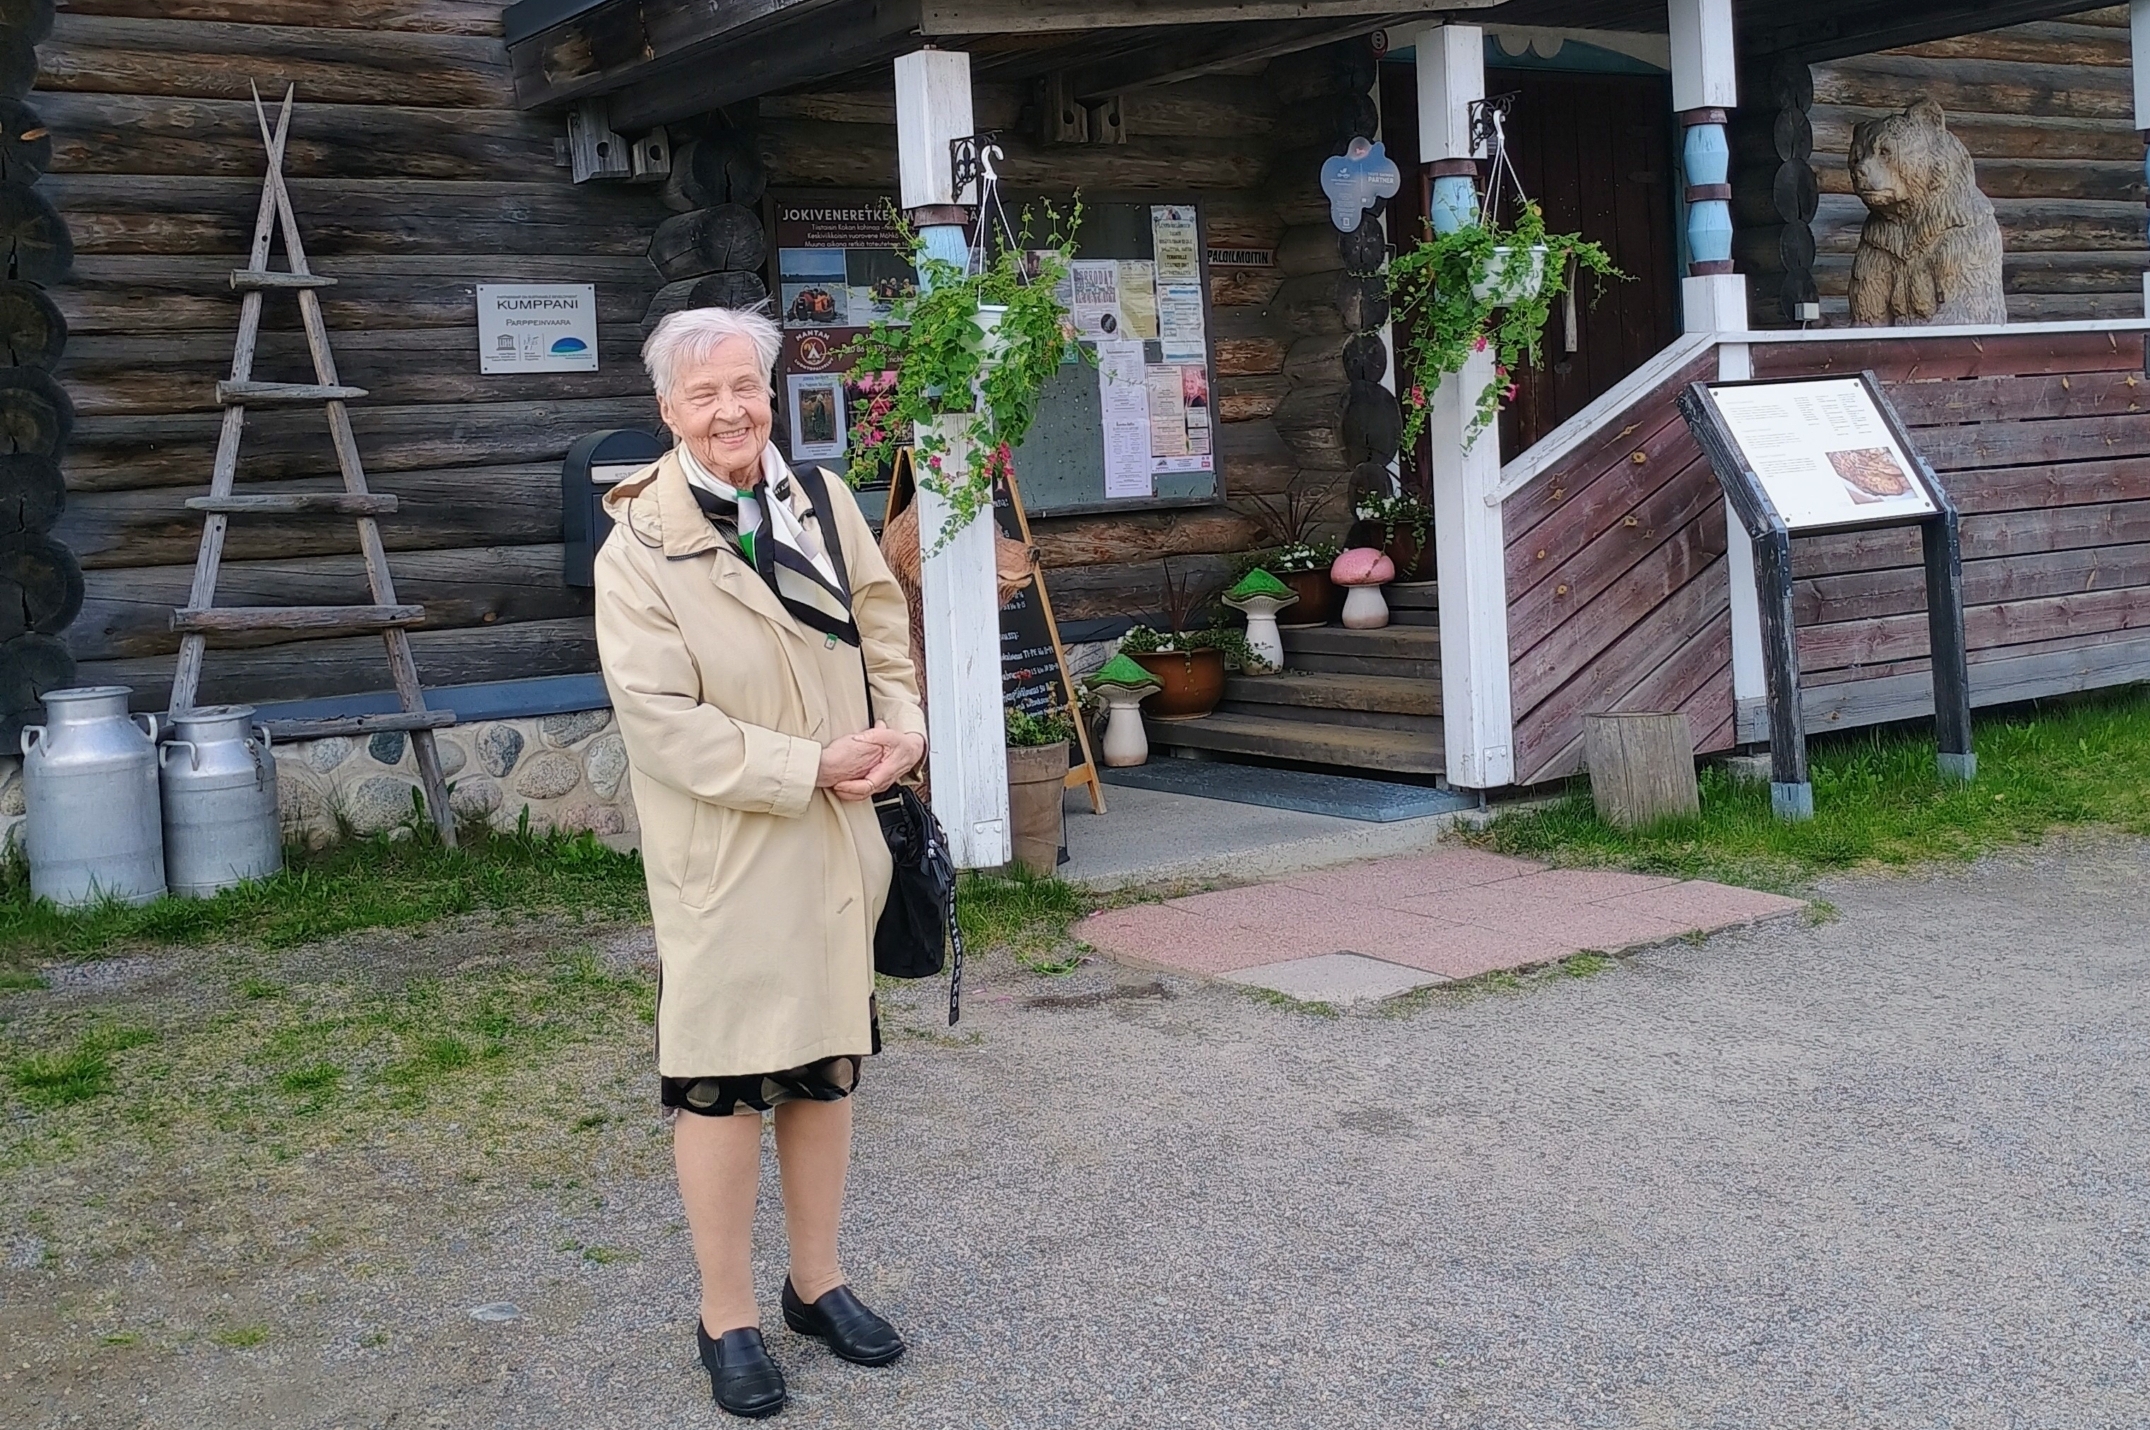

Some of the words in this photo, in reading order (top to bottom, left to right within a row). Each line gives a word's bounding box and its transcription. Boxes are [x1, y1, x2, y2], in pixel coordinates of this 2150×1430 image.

[1208, 250, 1268, 264] PALOILMOITIN
[497, 300, 578, 310] KUMPPANI
[795, 330, 830, 341] MANTAN
[949, 886, 962, 1008] marimekko
